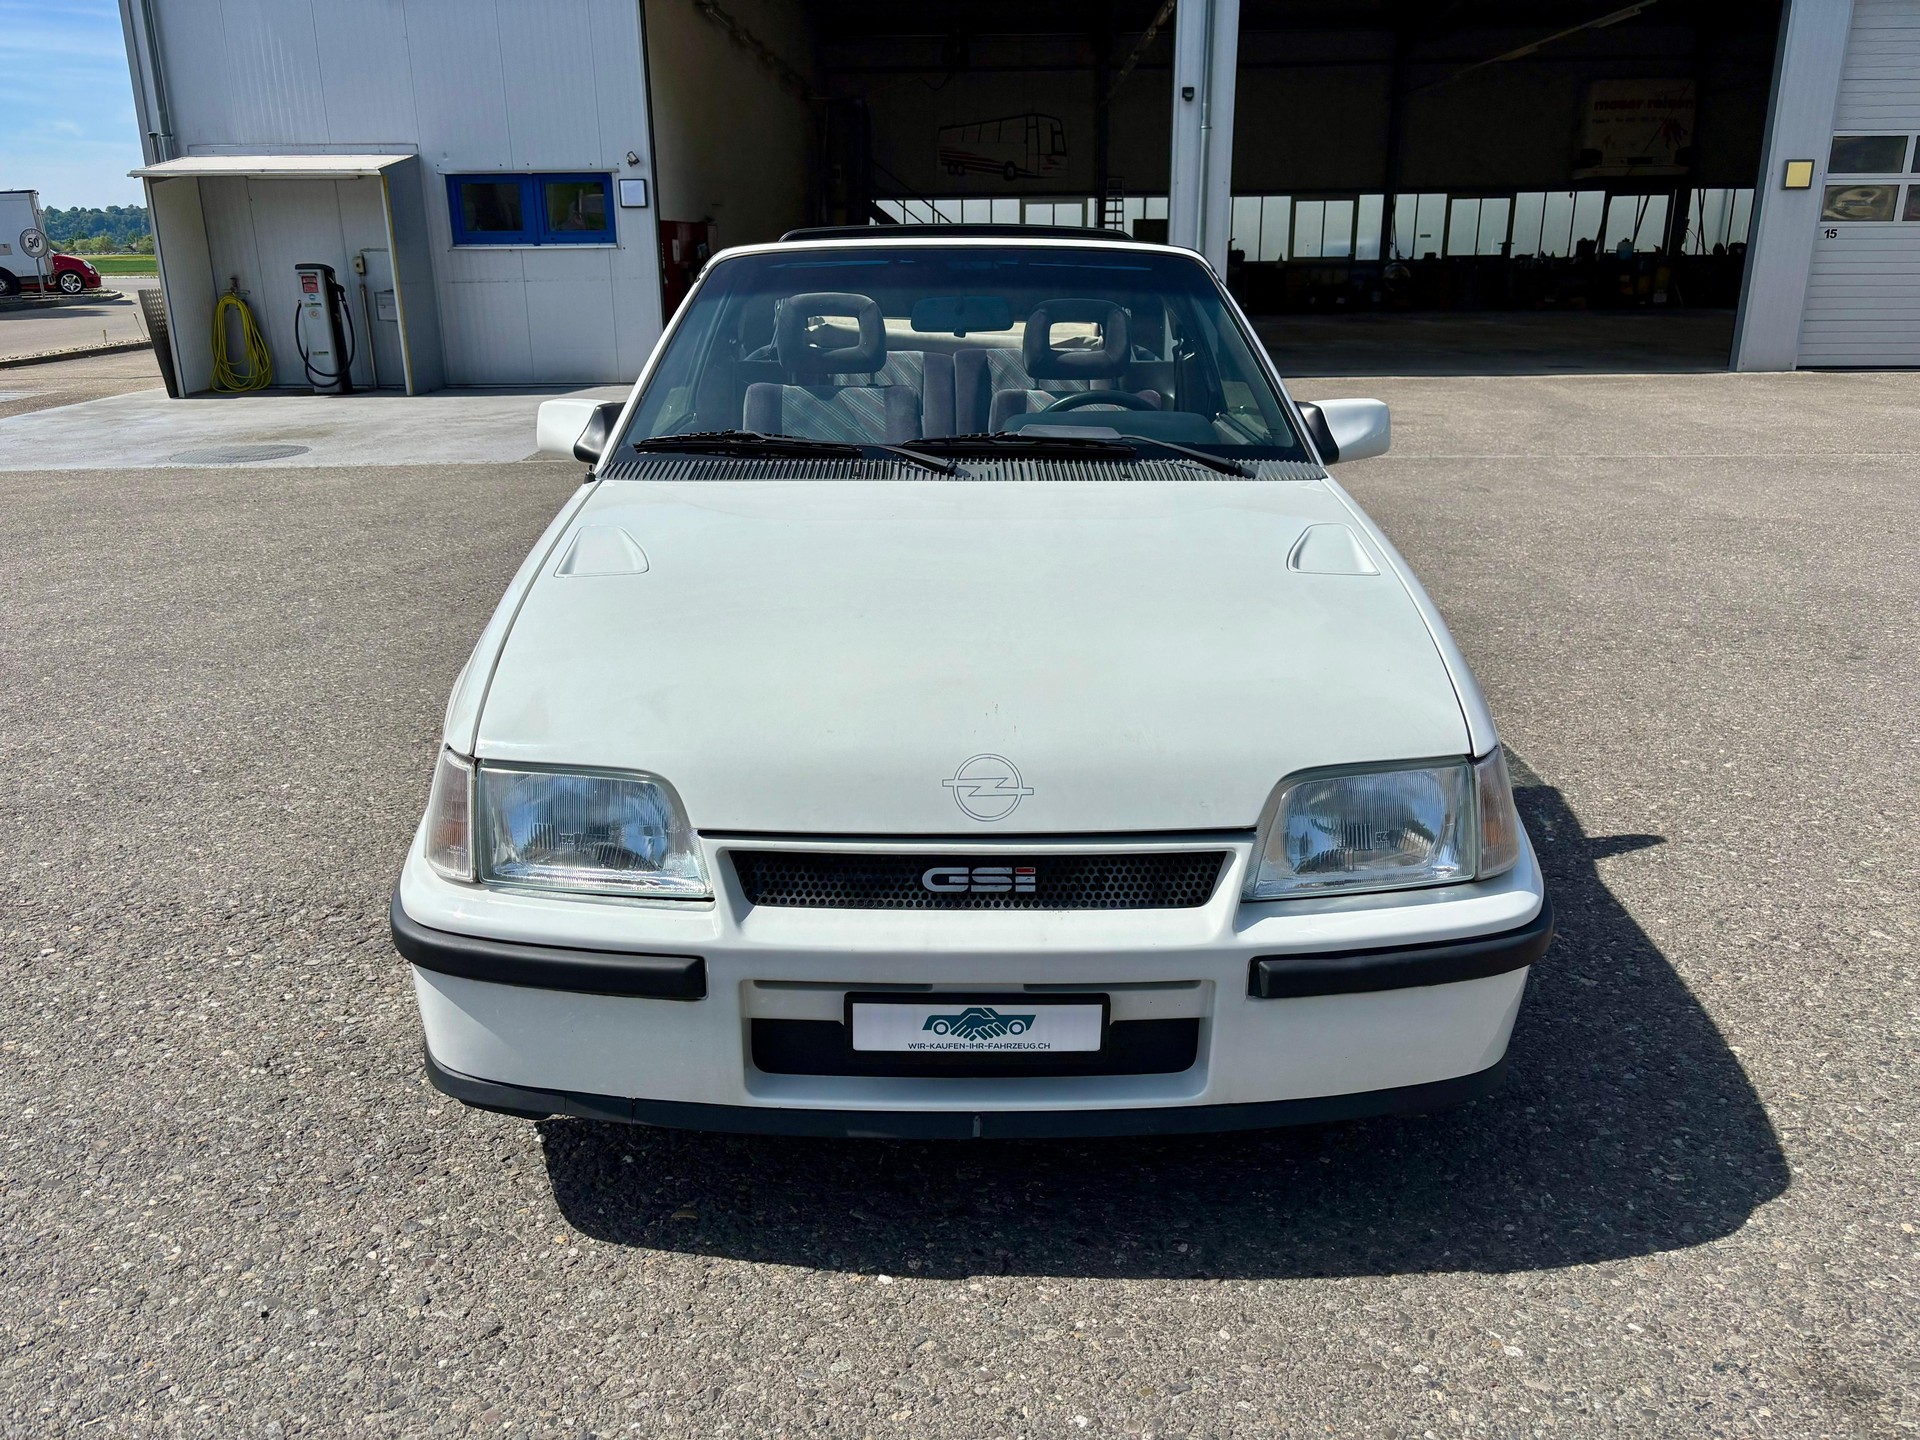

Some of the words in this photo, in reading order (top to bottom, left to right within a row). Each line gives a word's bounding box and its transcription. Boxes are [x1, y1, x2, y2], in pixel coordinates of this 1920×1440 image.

[1824, 229, 1837, 239] 15
[28, 238, 40, 248] 50
[908, 1042, 1051, 1050] WIR-KAUFEN-IHR-FAHRZEUG.CH
